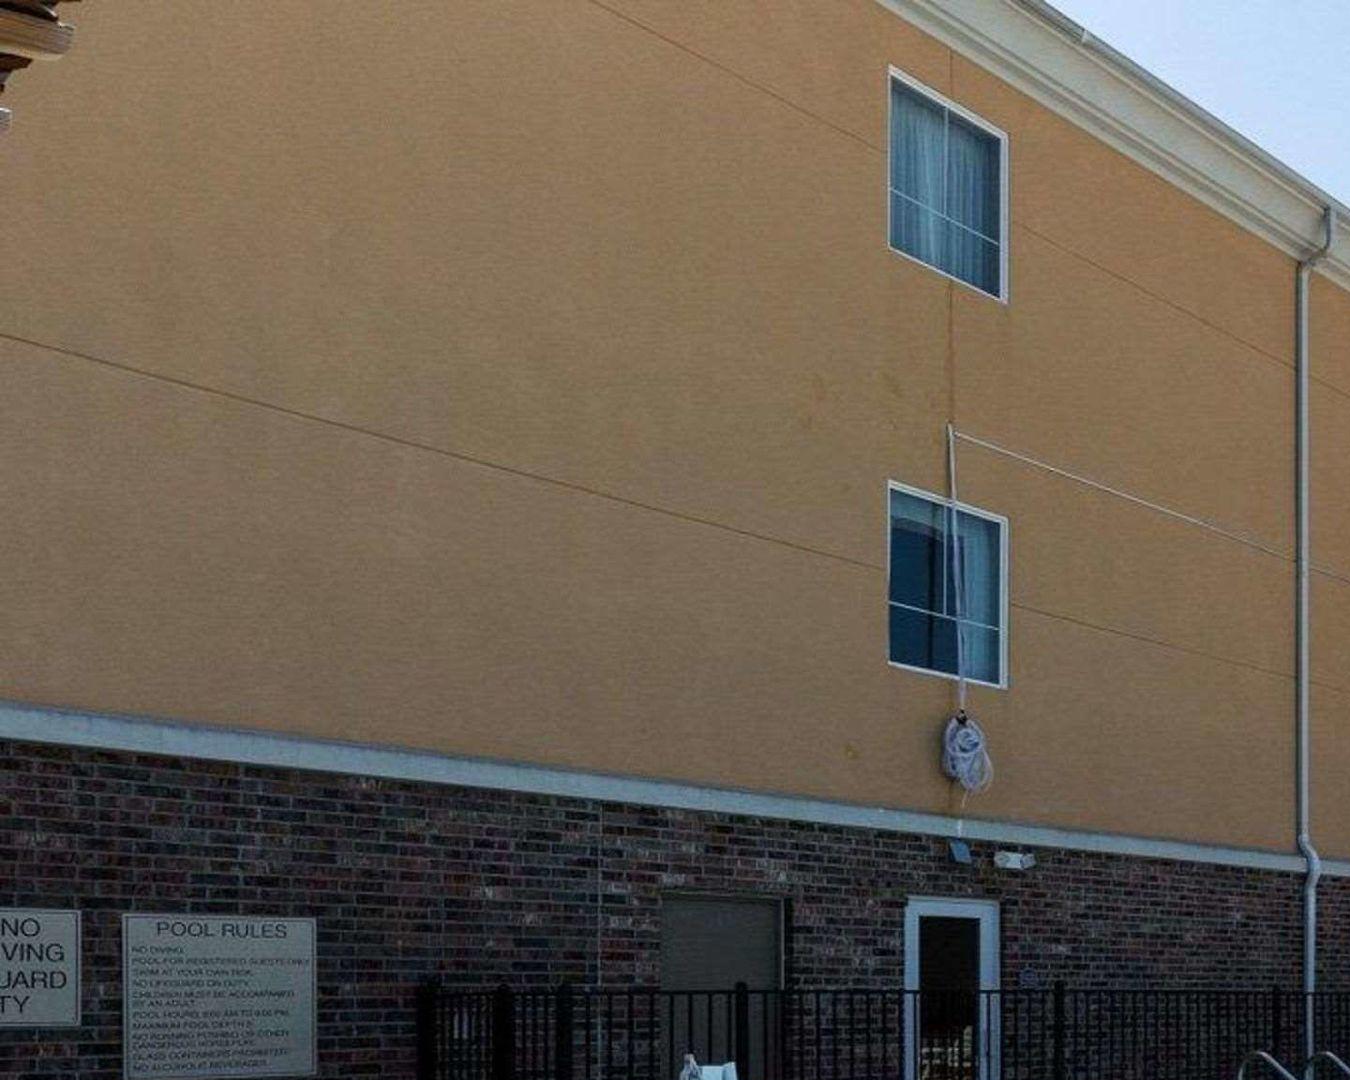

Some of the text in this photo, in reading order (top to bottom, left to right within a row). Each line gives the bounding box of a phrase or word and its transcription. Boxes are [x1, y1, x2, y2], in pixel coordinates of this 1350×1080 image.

[1, 918, 41, 937] NO
[156, 921, 288, 939] POOL RULES
